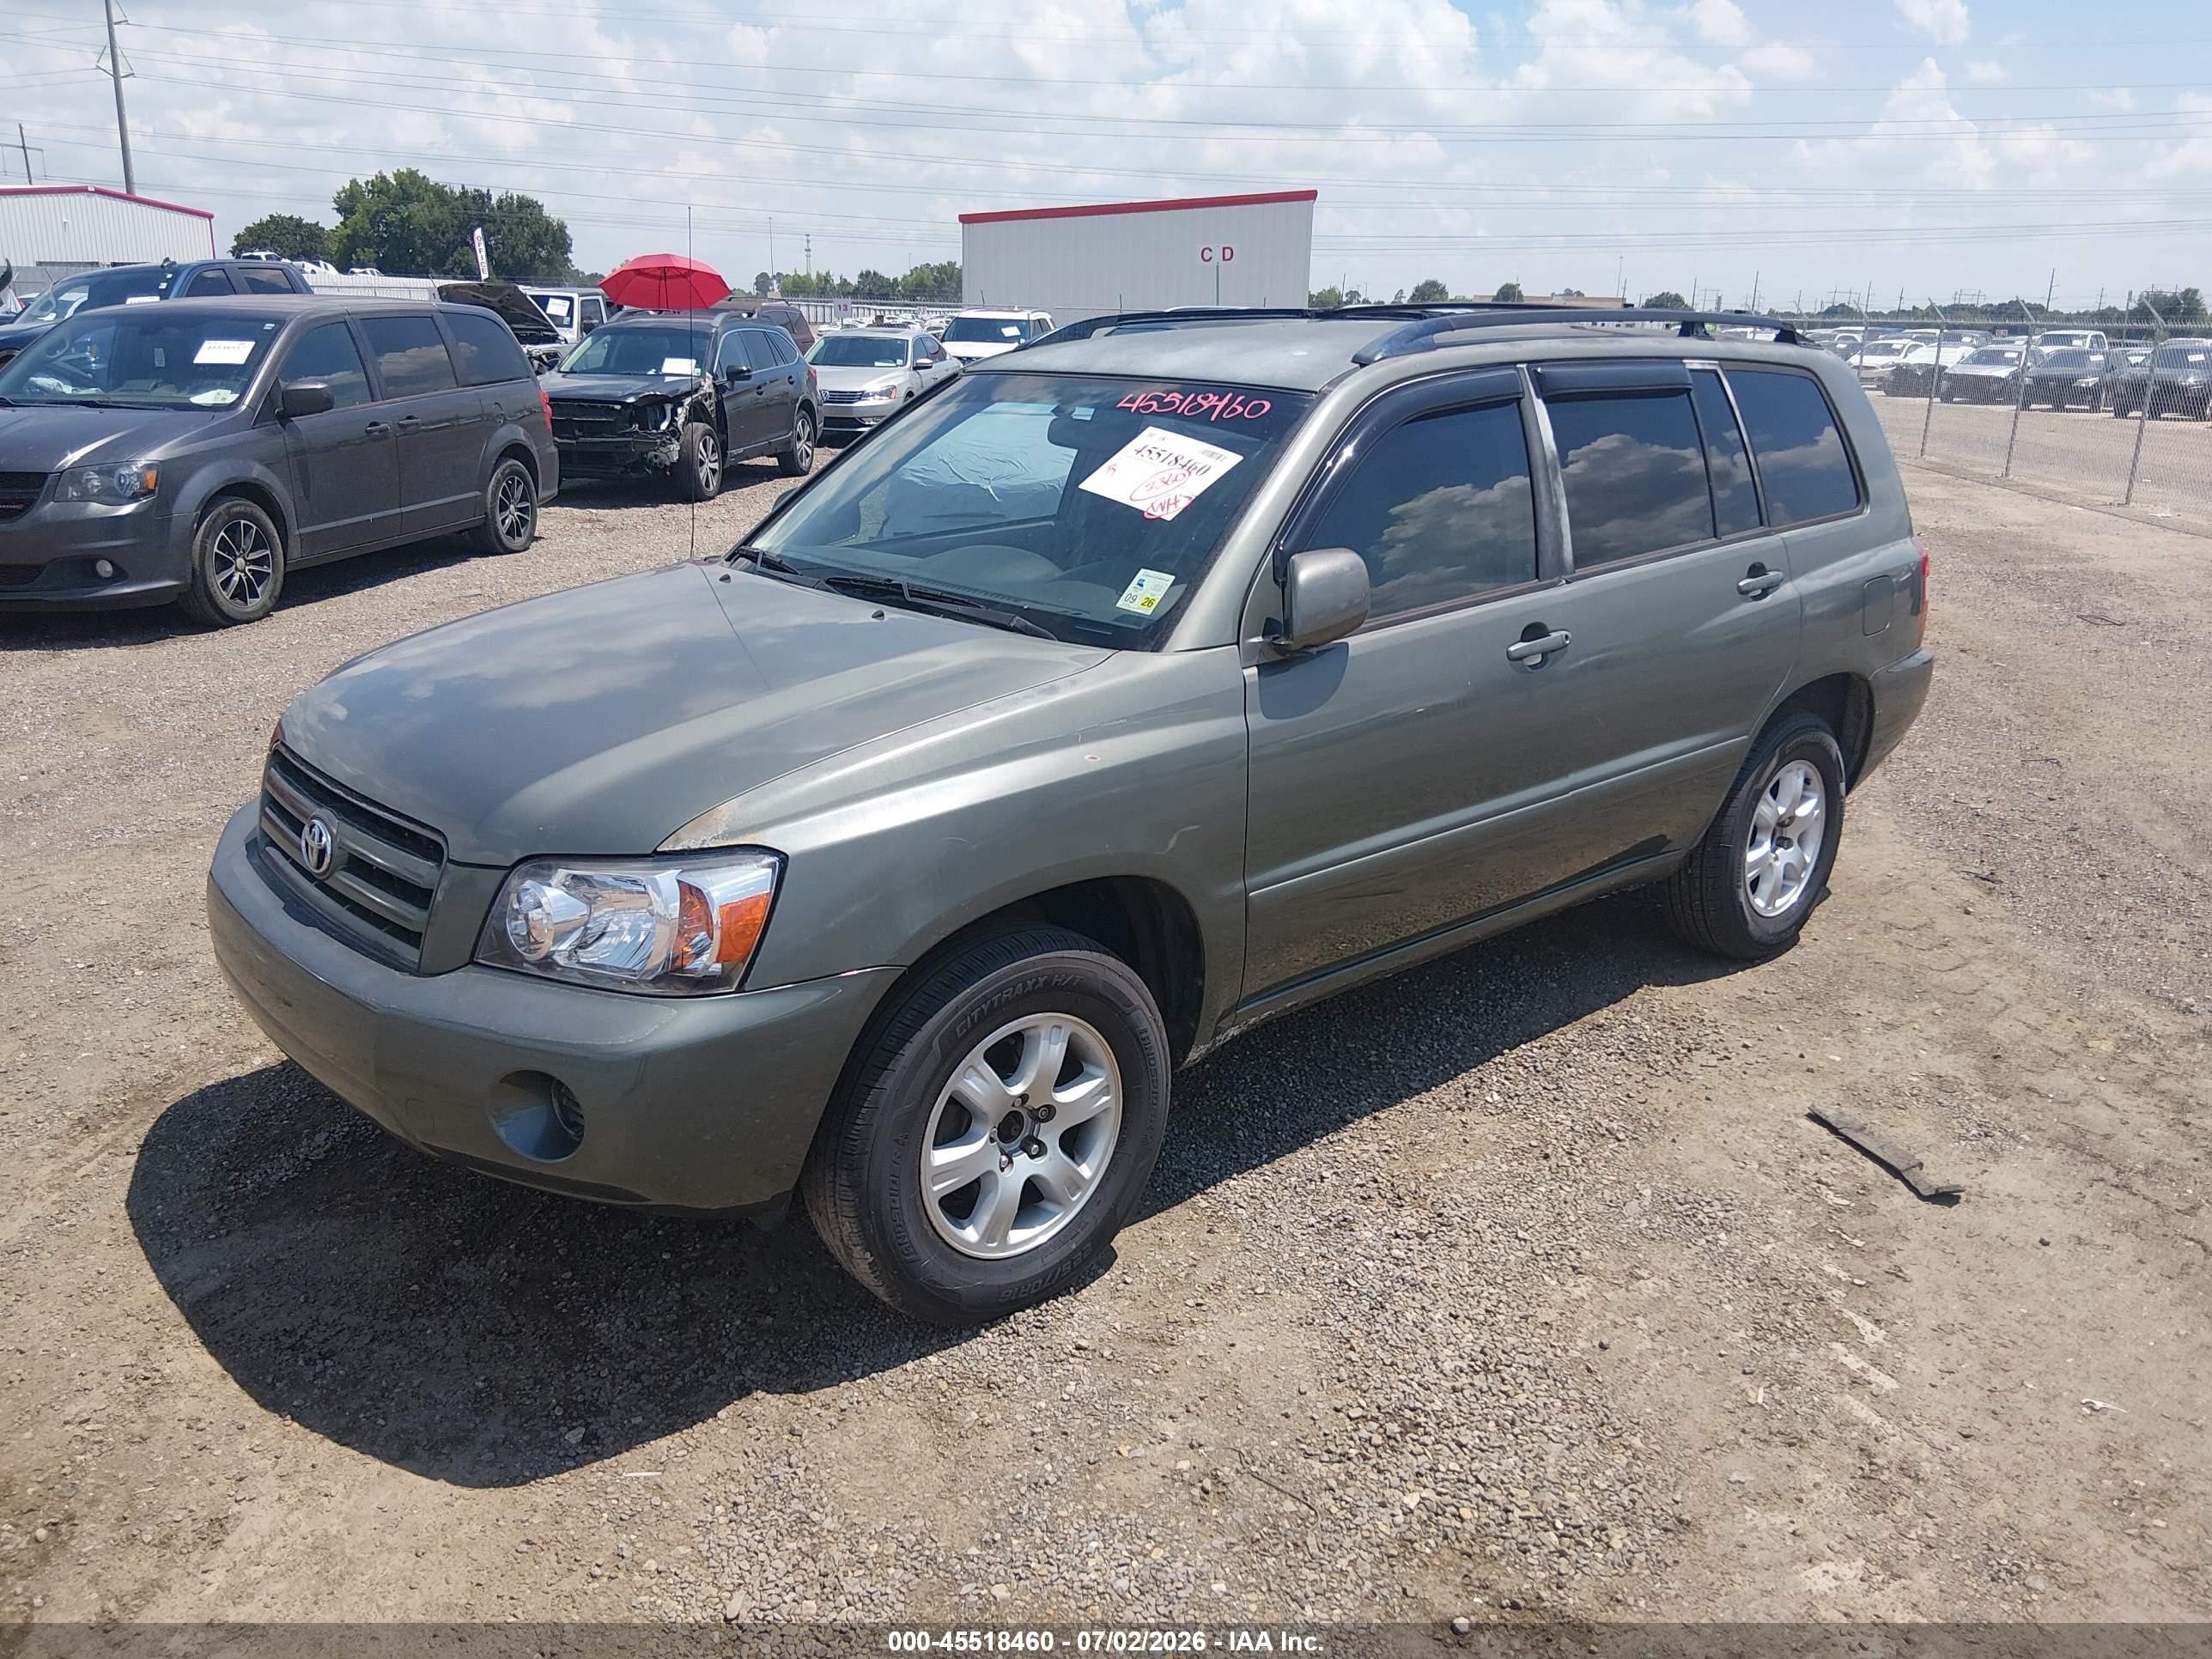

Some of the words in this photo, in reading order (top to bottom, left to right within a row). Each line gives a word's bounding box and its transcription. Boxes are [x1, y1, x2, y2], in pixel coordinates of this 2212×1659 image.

[477, 235, 488, 275] OFFICE
[1200, 246, 1212, 262] C
[1222, 246, 1234, 262] D
[1116, 392, 1272, 422] 45518460
[1134, 445, 1212, 477] 45518460
[1124, 592, 1139, 604] 09
[1140, 597, 1156, 608] 26
[955, 975, 1048, 1039] CITYTRAXX
